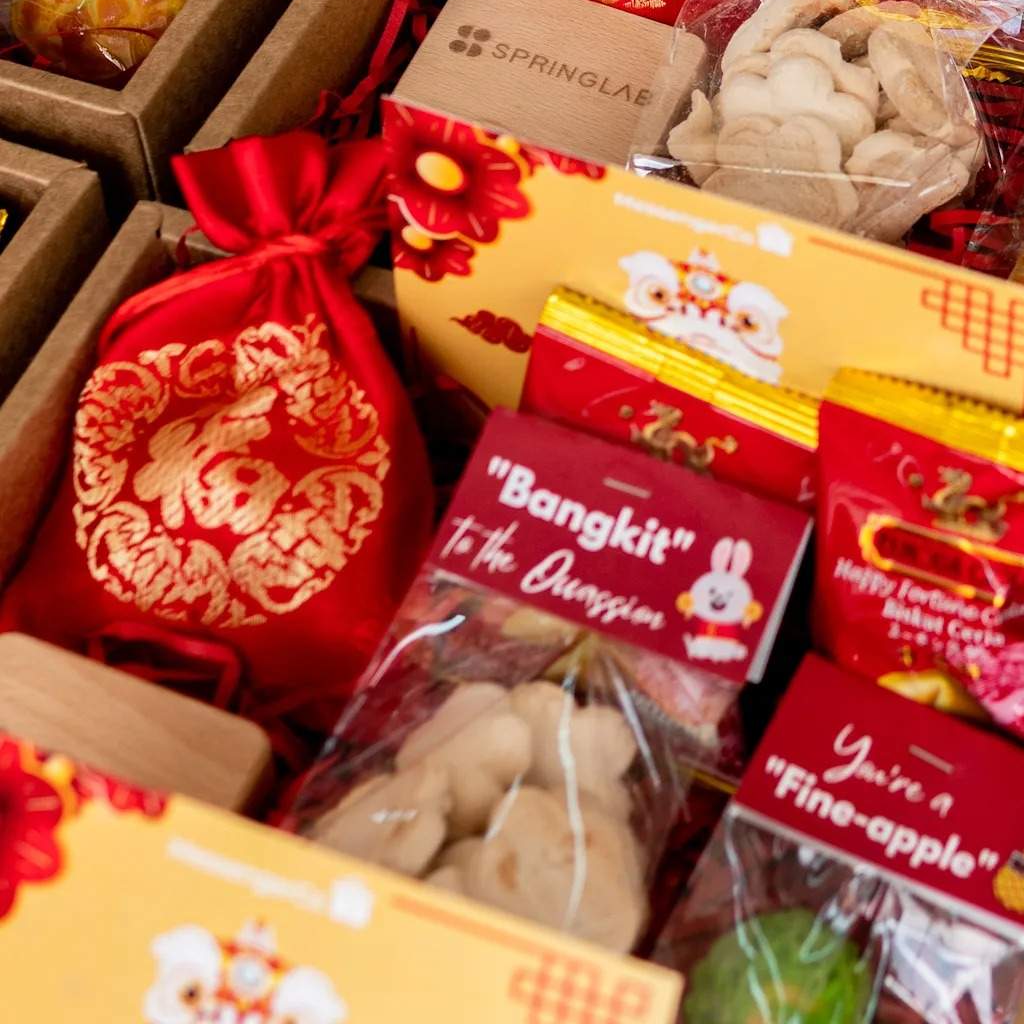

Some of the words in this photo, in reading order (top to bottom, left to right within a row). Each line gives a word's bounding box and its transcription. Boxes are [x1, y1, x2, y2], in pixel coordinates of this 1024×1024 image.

[487, 456, 695, 565] "Bangkit"
[765, 754, 999, 879] "Fine-apple"
[822, 723, 925, 803] You're
[929, 792, 954, 819] a
